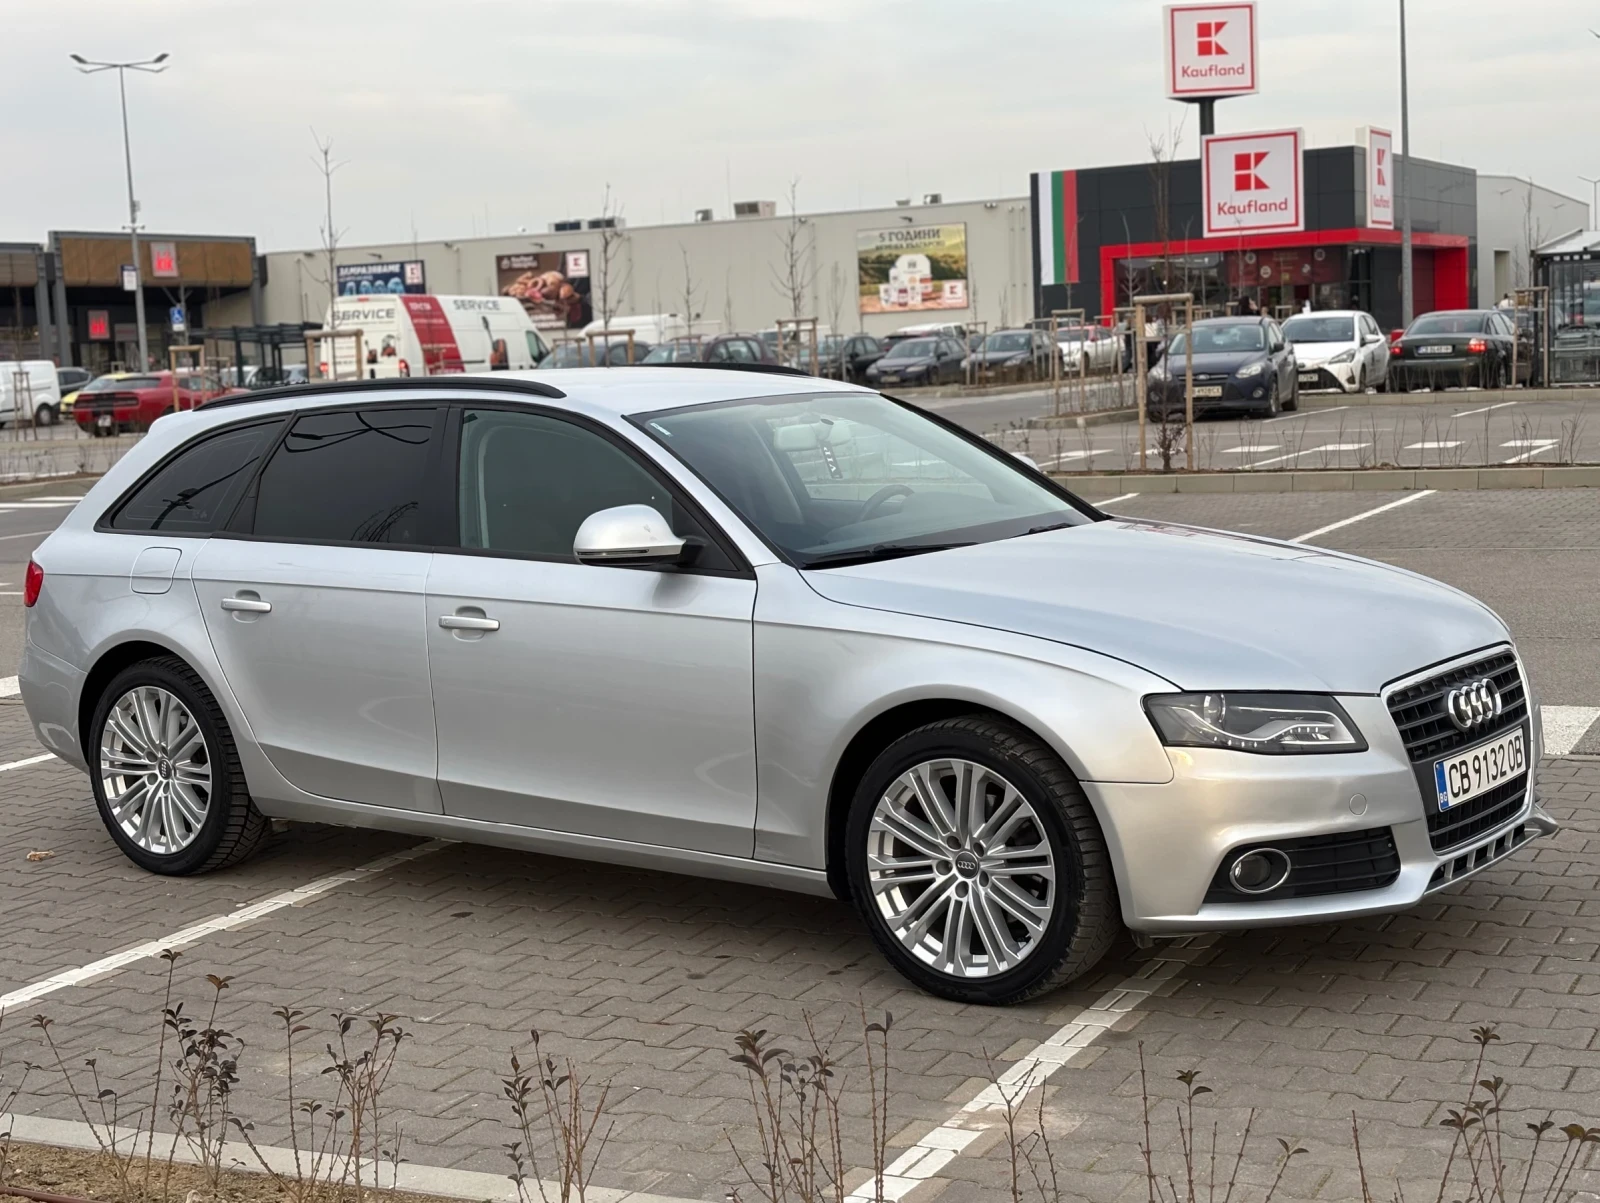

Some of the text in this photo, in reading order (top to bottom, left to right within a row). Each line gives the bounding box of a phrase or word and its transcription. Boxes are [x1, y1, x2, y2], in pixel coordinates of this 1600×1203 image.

[1181, 63, 1245, 78] Kaufland
[1217, 198, 1288, 216] Kaufland
[888, 228, 941, 242] ГОДИНИ
[453, 299, 501, 311] SERVICE
[334, 308, 395, 321] SERVICE
[1448, 735, 1523, 798] CB 9132 OB
[1440, 791, 1448, 803] BG
